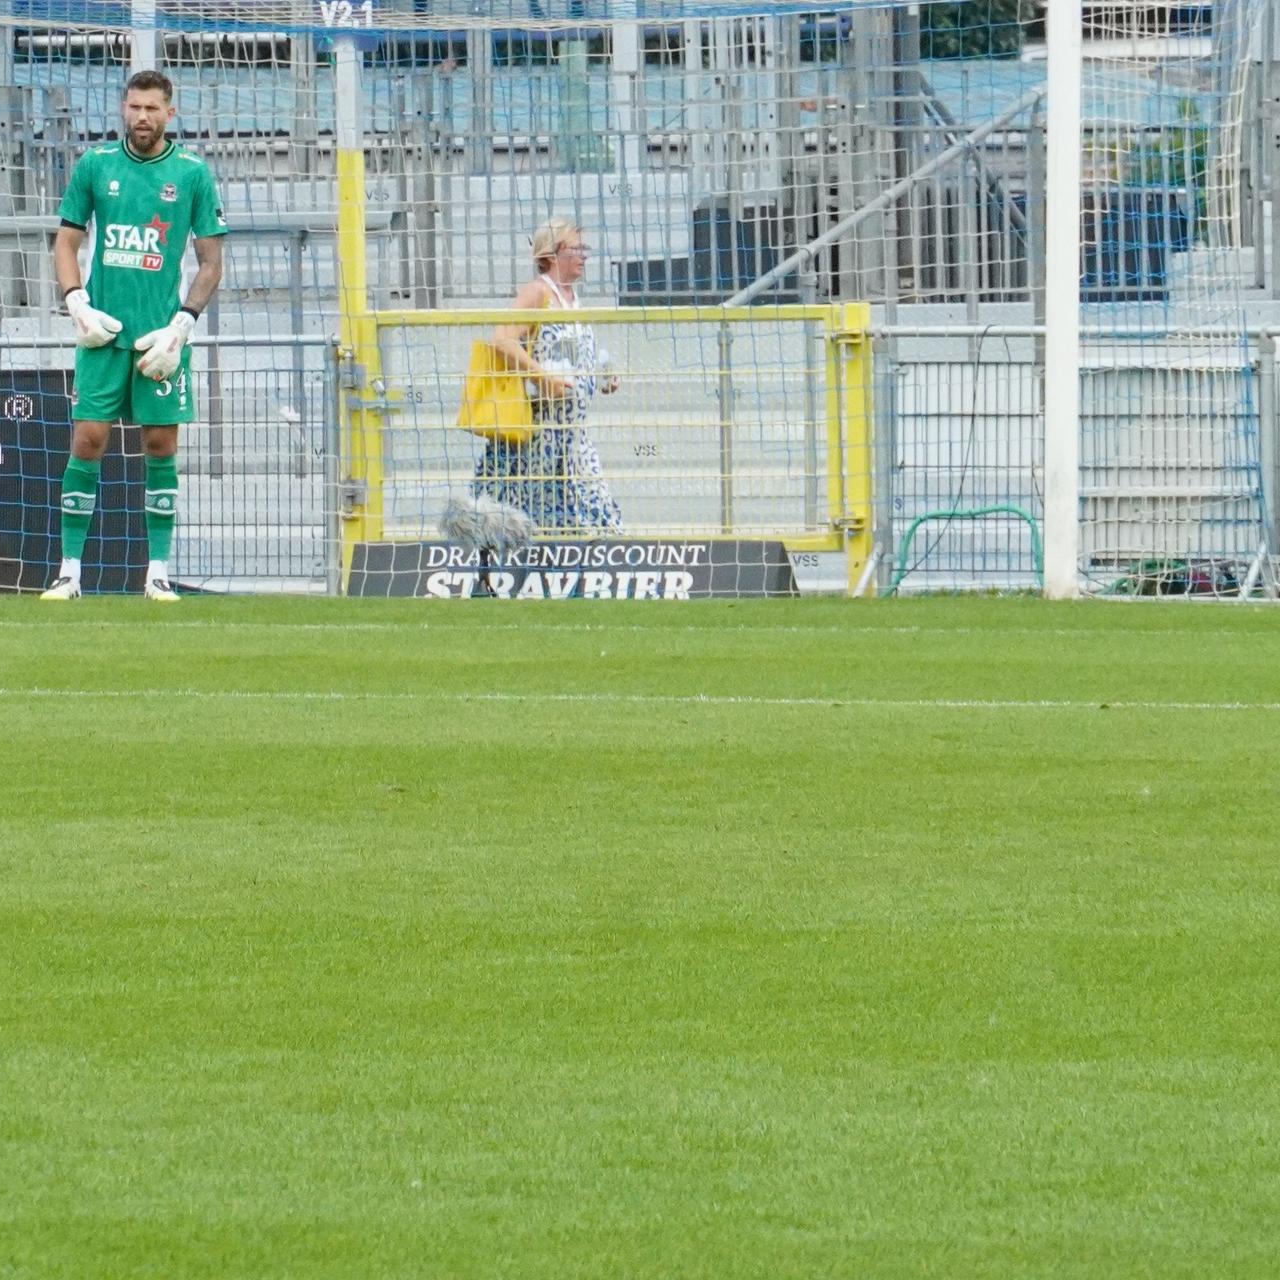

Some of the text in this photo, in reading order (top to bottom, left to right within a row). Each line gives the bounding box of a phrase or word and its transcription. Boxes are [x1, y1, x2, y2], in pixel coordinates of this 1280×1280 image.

[320, 0, 373, 28] V2.1
[104, 223, 160, 253] STAR
[145, 256, 161, 267] TV
[793, 555, 819, 567] VSS
